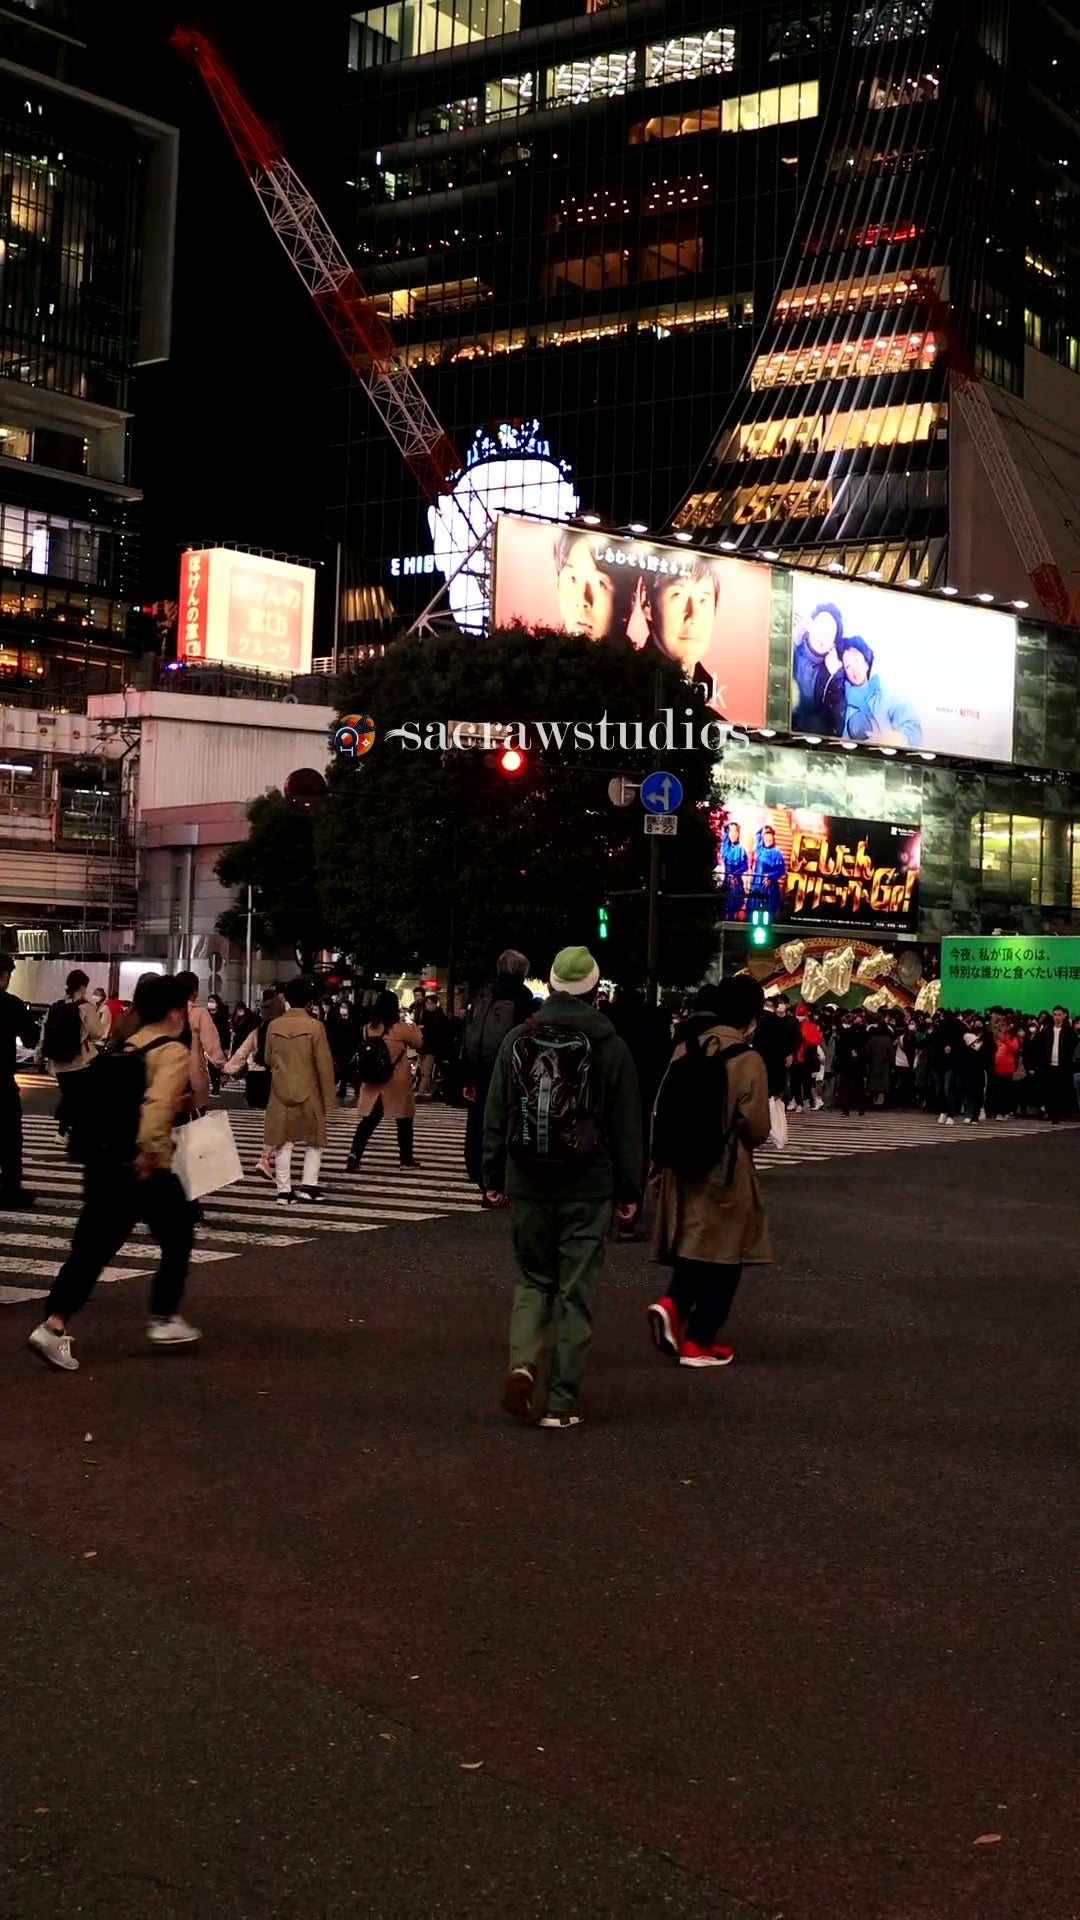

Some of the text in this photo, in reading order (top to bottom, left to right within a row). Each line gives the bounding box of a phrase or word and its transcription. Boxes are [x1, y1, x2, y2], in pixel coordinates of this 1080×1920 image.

[790, 833, 875, 880] にしたん
[949, 947, 1050, 961] 今夜、私が頂くのは、
[948, 965, 1080, 980] 特別な誰かと食べたい料理
